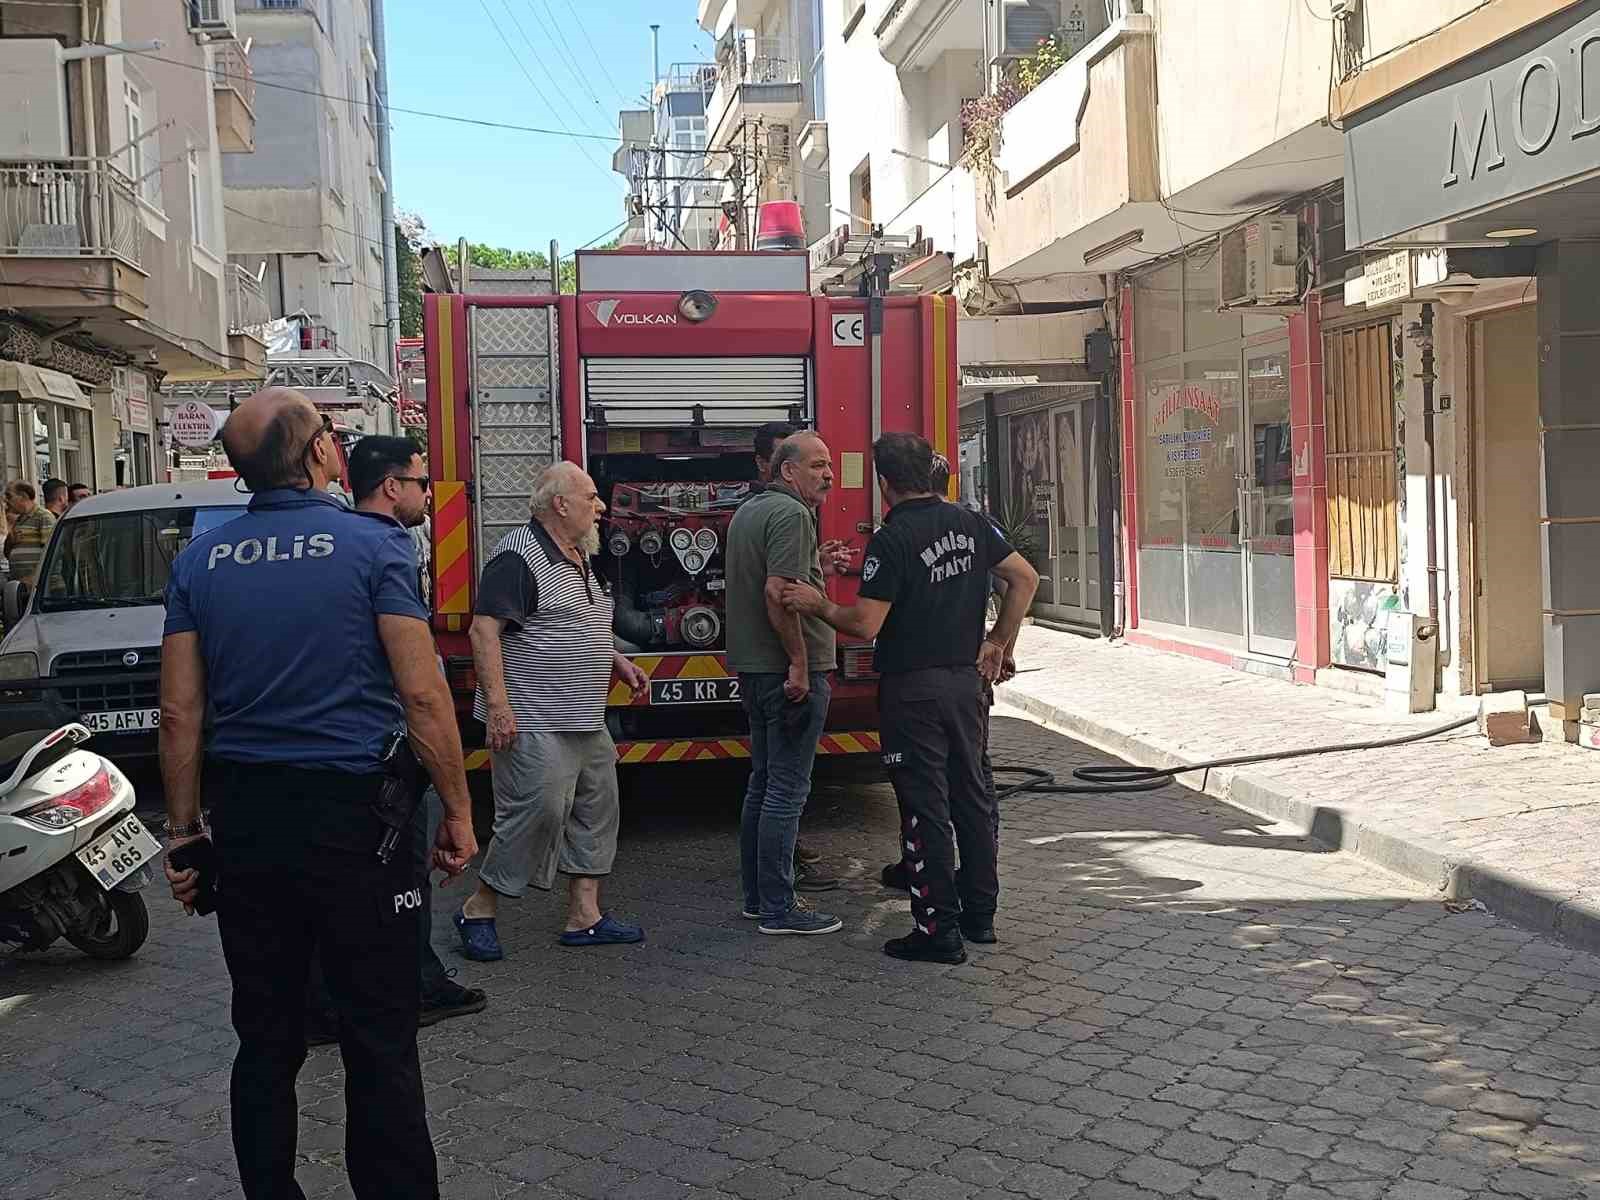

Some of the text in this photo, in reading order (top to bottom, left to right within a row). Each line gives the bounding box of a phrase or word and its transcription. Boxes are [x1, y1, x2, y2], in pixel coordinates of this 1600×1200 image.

[613, 313, 677, 324] VOLKAN
[834, 320, 863, 340] CE
[207, 533, 336, 570] POLİS
[660, 680, 741, 701] 45 KR 2
[90, 710, 160, 730] 45 AFV 8
[86, 821, 140, 866] 45 AVG
[112, 846, 142, 873] 865
